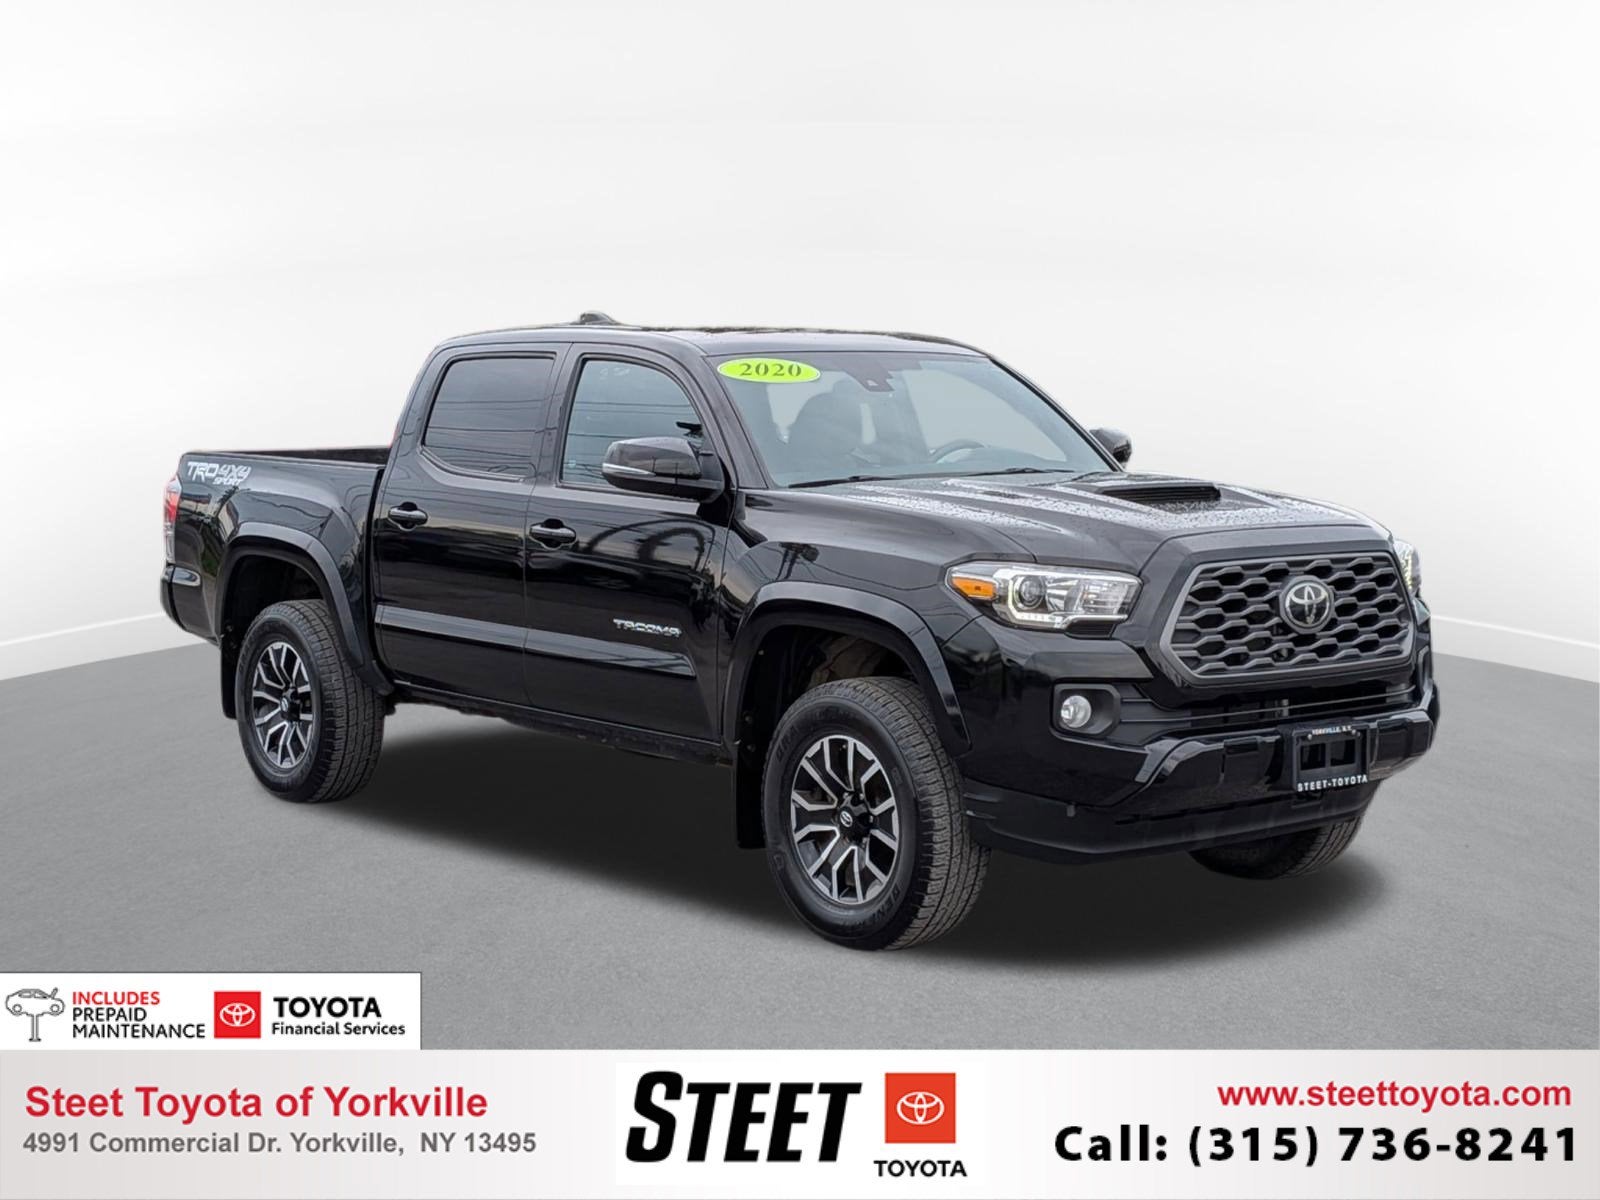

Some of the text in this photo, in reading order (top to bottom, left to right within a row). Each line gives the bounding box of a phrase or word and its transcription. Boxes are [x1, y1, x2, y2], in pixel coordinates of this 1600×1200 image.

[739, 362, 802, 377] 2020
[187, 461, 220, 483] TRD
[613, 618, 682, 638] TACOMA
[1297, 774, 1368, 792] STEET-TOYOTA
